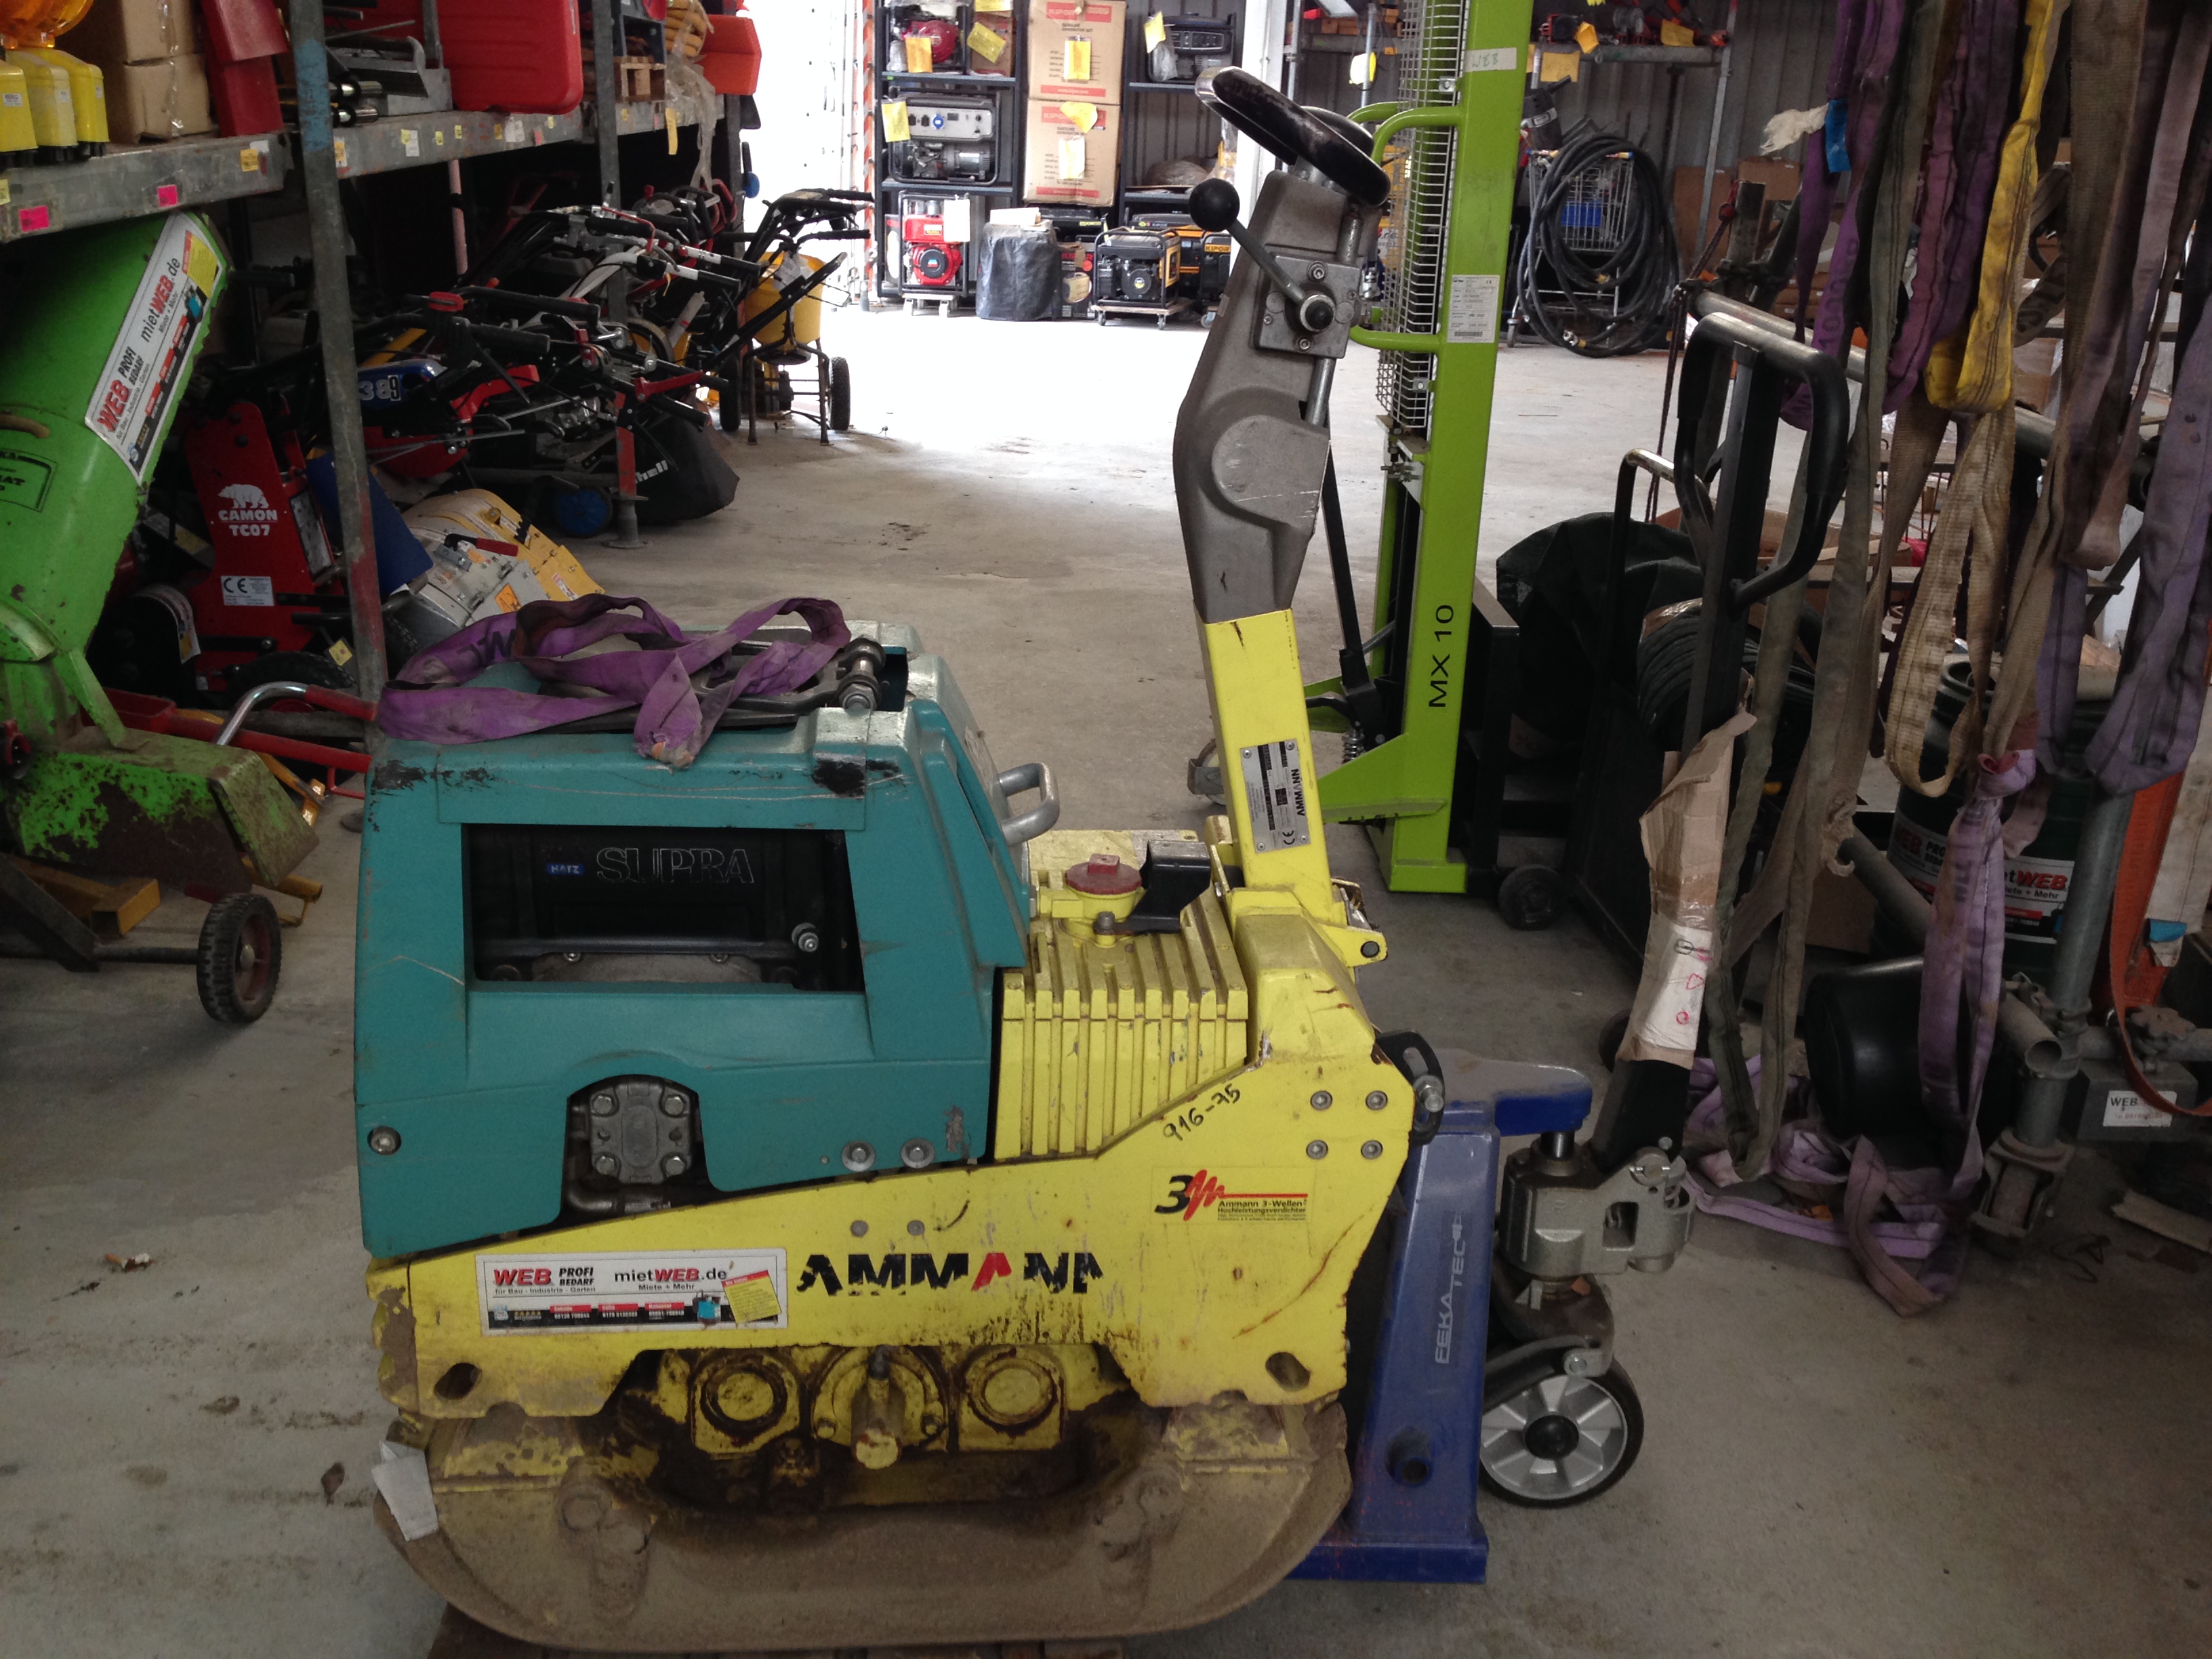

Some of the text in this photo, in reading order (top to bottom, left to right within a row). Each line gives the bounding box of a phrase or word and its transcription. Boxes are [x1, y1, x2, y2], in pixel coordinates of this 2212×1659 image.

[140, 258, 181, 343] mietWEB.de
[127, 356, 145, 386] BEDARF
[97, 346, 138, 432] WEB PROFI
[218, 510, 278, 520] CAMON
[224, 577, 248, 594] CE
[1429, 605, 1454, 708] MX 10
[1291, 769, 1306, 817] AMMANN
[1282, 830, 1295, 845] CE
[550, 865, 580, 874] HATZ
[596, 847, 754, 883] SUPRA
[2110, 1097, 2137, 1107] WEB
[493, 1267, 727, 1286] WEB PROFI mietWEB.de
[559, 1277, 594, 1286] BEDARF
